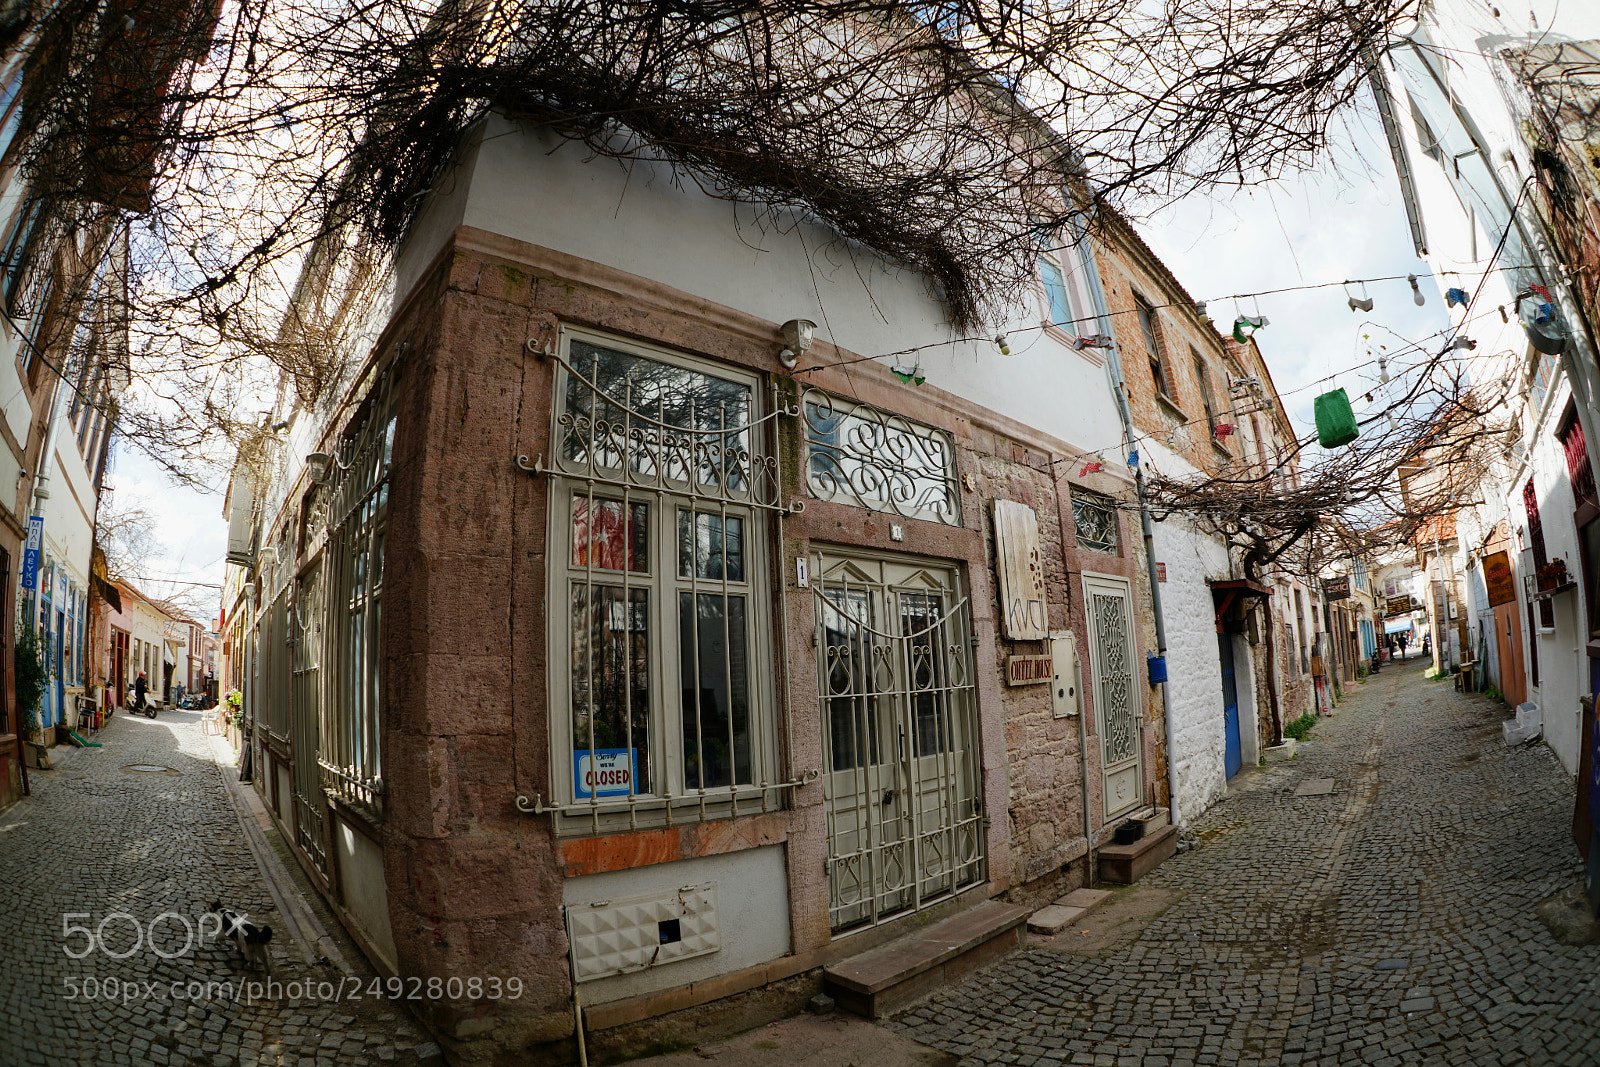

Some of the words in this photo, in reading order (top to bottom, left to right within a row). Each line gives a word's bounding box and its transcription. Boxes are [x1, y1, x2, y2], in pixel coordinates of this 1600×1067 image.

[30, 521, 40, 549] ΜΠΛΕ
[25, 550, 35, 587] ΛΕΥΚΟ
[1011, 660, 1032, 681] COFFEE
[1034, 659, 1052, 679] HOUSE
[595, 751, 618, 761] Sorry
[586, 769, 629, 786] CLOSED
